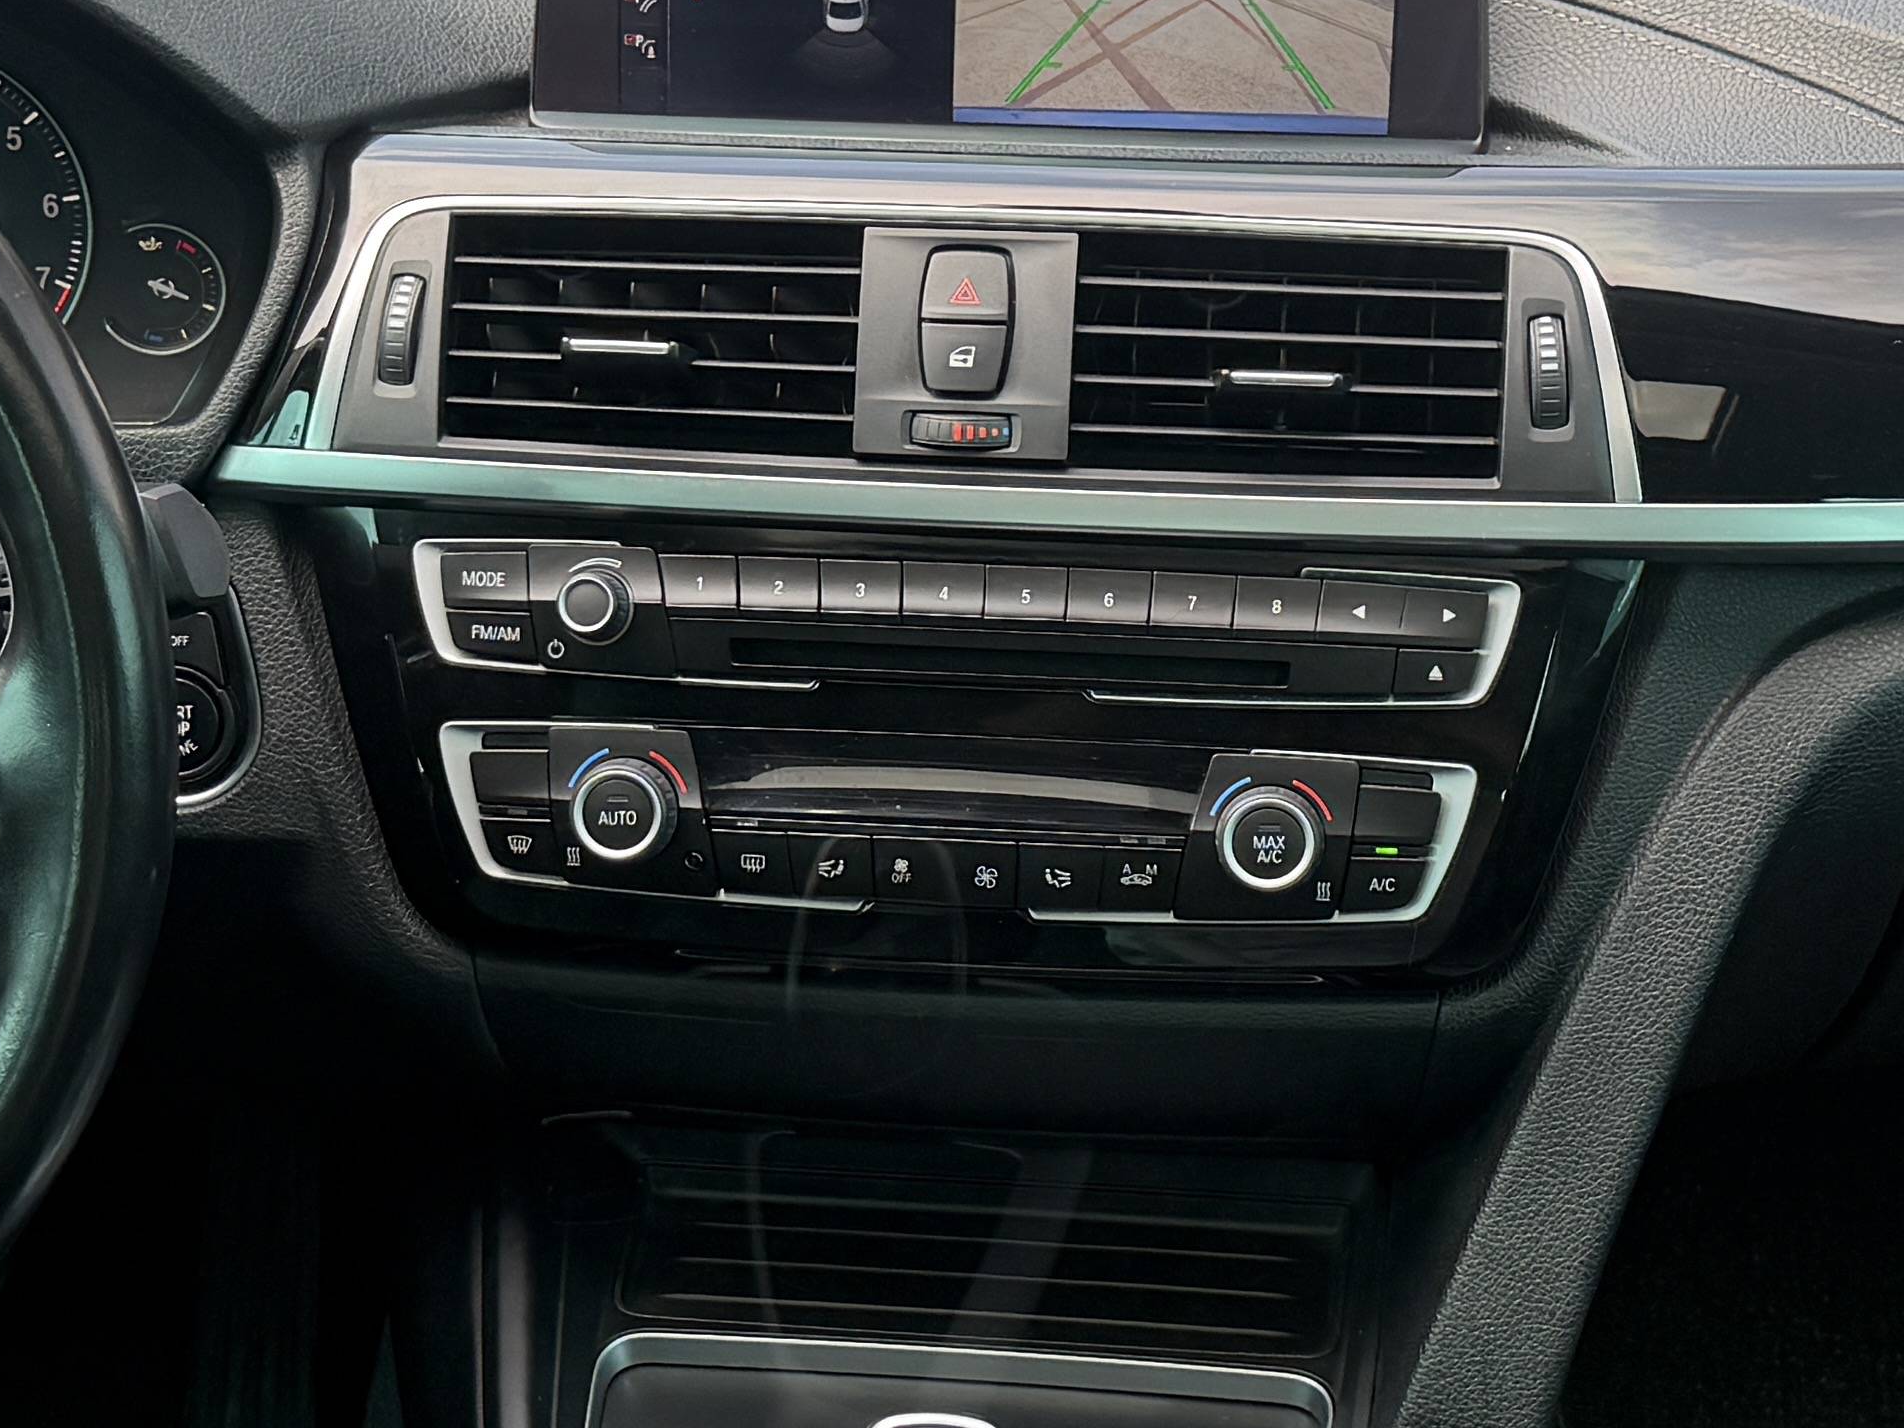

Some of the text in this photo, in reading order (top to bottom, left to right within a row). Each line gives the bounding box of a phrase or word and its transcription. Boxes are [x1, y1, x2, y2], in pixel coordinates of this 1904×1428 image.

[6, 126, 22, 151] 5
[42, 193, 60, 218] 6
[35, 266, 52, 290] 7
[462, 570, 506, 588] MODE
[696, 576, 704, 592] 1
[773, 580, 784, 596] 2
[855, 583, 866, 598] 3
[939, 586, 949, 601] 4
[1021, 589, 1031, 604] 5
[1103, 592, 1114, 608] 6
[1187, 595, 1197, 611] 7
[1271, 599, 1282, 614] 8
[471, 624, 521, 642] FM/AM
[598, 810, 637, 826] AUTO
[1253, 835, 1285, 850] MAX
[1257, 850, 1283, 864] A/C
[891, 872, 912, 884] OFF
[1369, 878, 1396, 892] A/C
